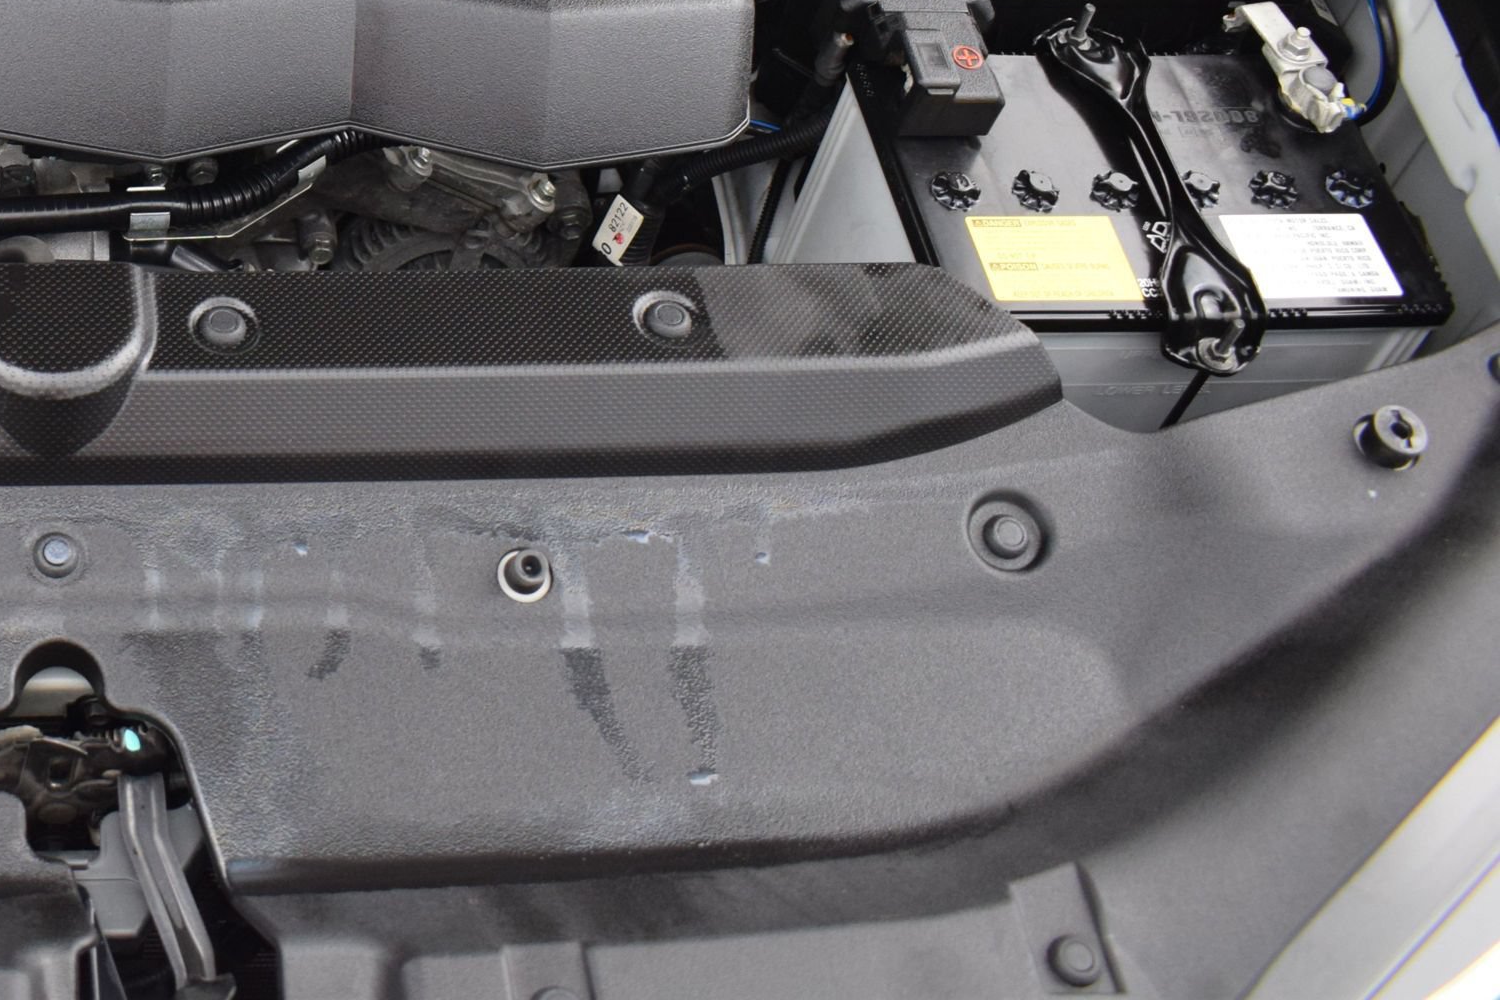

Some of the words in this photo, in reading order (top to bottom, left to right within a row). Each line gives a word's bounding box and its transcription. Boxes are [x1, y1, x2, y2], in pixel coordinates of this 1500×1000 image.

[607, 201, 629, 233] 82122
[1000, 263, 1037, 271] POISON
[1092, 384, 1156, 396] LOWER
